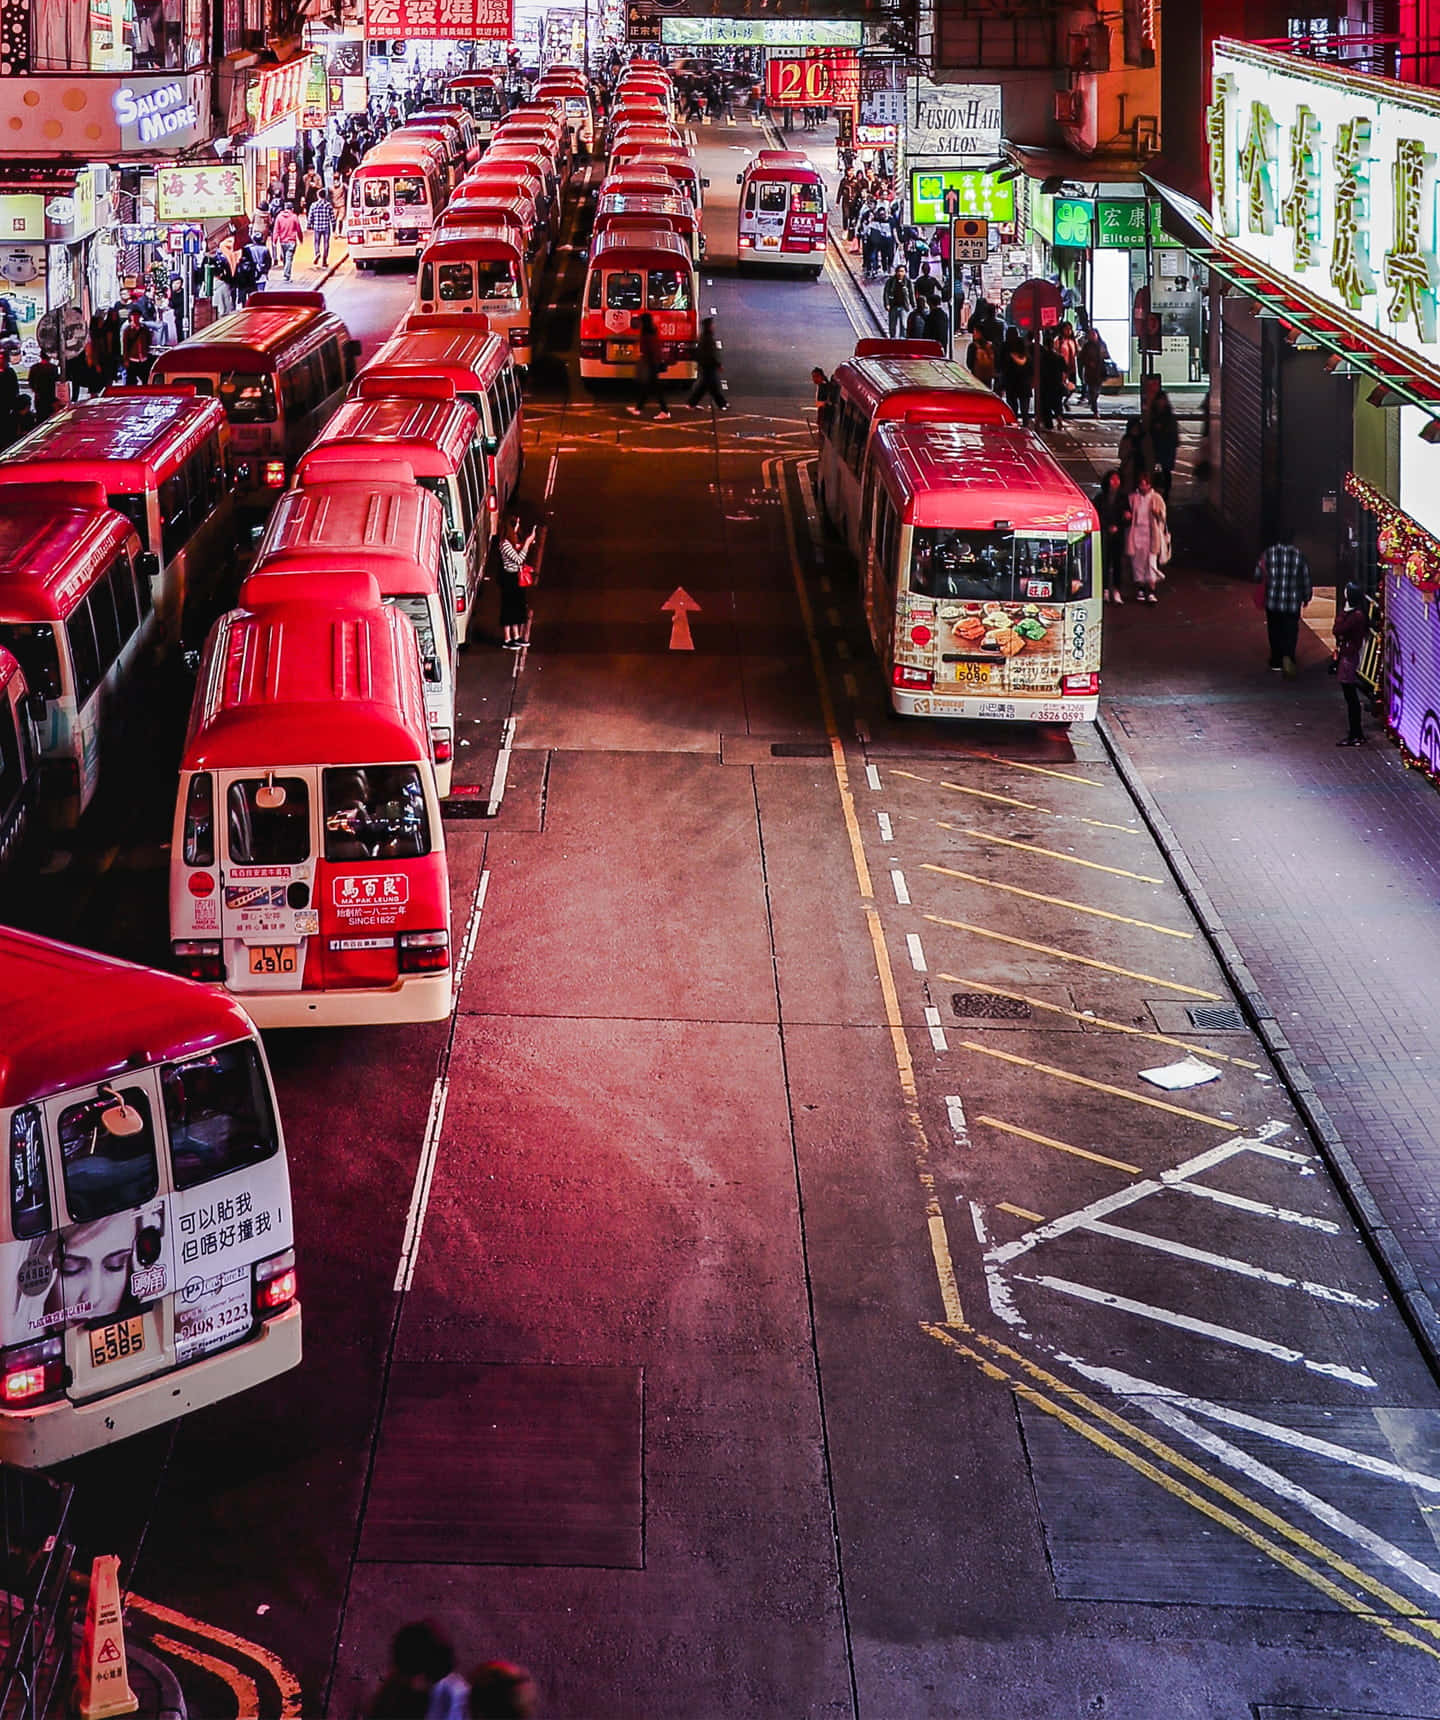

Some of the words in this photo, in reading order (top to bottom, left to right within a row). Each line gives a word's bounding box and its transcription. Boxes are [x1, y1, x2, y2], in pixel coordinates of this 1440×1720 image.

[115, 83, 182, 123] SALON
[139, 105, 197, 142] MORE
[937, 137, 978, 152] SALON
[163, 170, 240, 197] 海天堂
[1103, 233, 1156, 243] Elitecae
[961, 249, 980, 257] 全日
[979, 703, 1016, 712] 小巴廣告
[1038, 711, 1060, 720] 3526
[342, 877, 399, 898] 馬百良
[348, 917, 375, 925] SINCE
[262, 946, 284, 960] LY
[179, 1192, 252, 1234] 可以貼我
[217, 1303, 249, 1328] 3223
[104, 1321, 129, 1345] EN
[94, 1334, 143, 1365] 5385
